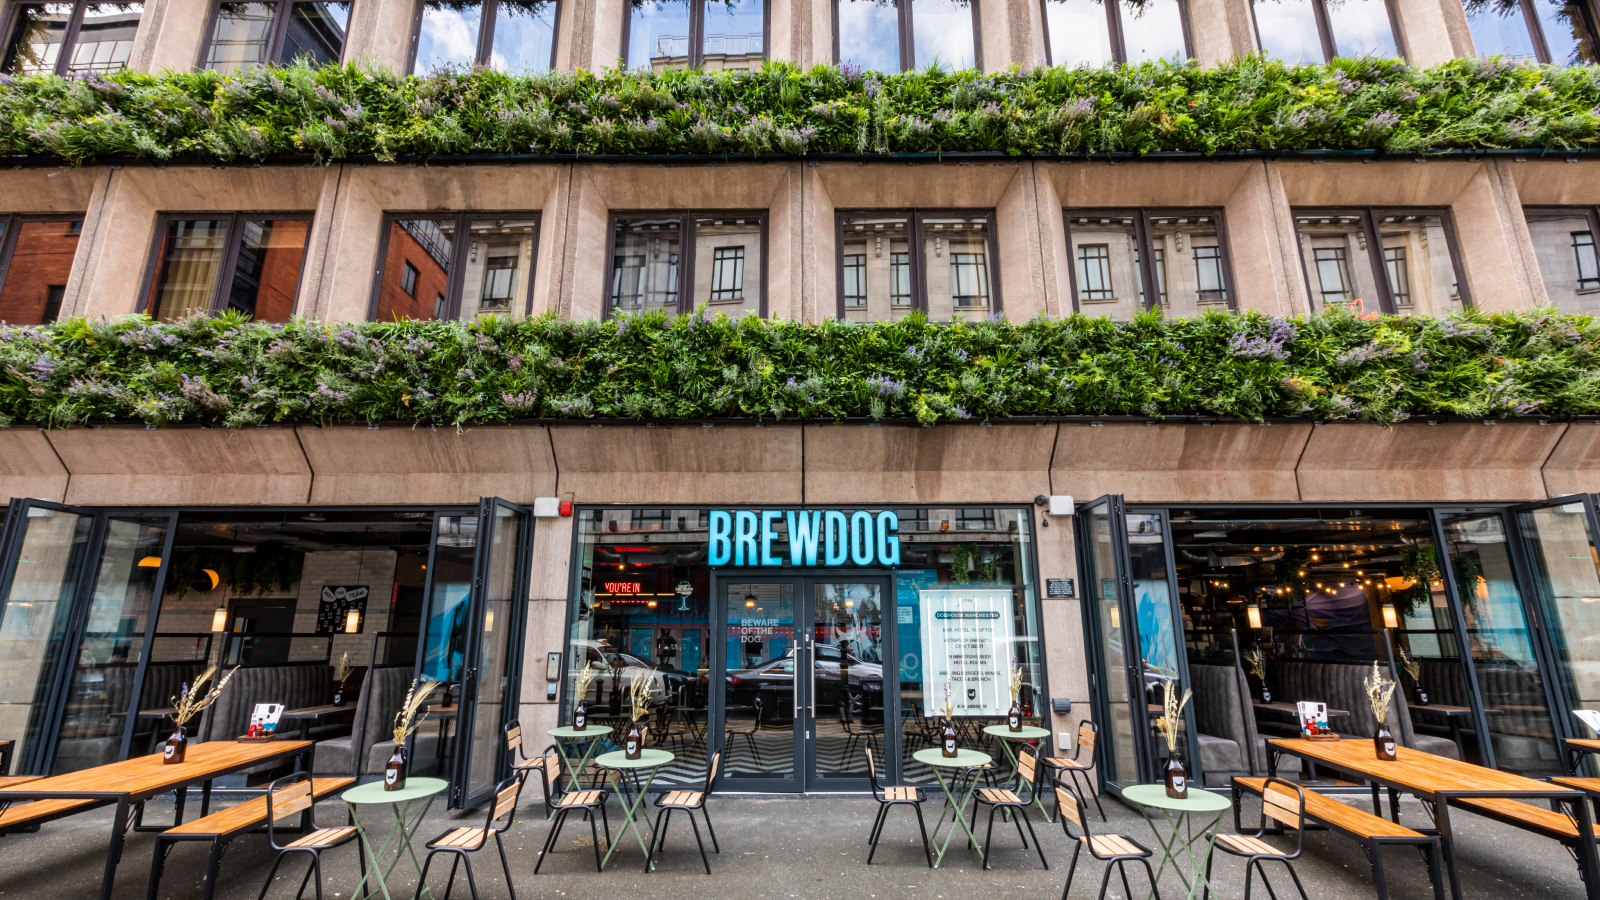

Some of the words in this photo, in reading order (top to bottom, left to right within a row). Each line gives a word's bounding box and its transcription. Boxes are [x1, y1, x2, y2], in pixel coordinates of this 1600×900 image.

[708, 510, 900, 566] BREWDOG
[604, 582, 632, 593] YOU'RE
[632, 582, 641, 593] IN
[348, 590, 365, 599] TEAM
[741, 618, 779, 627] BEWARE
[741, 627, 754, 635] OF
[756, 627, 774, 635] THE
[741, 635, 764, 643] DOG.
